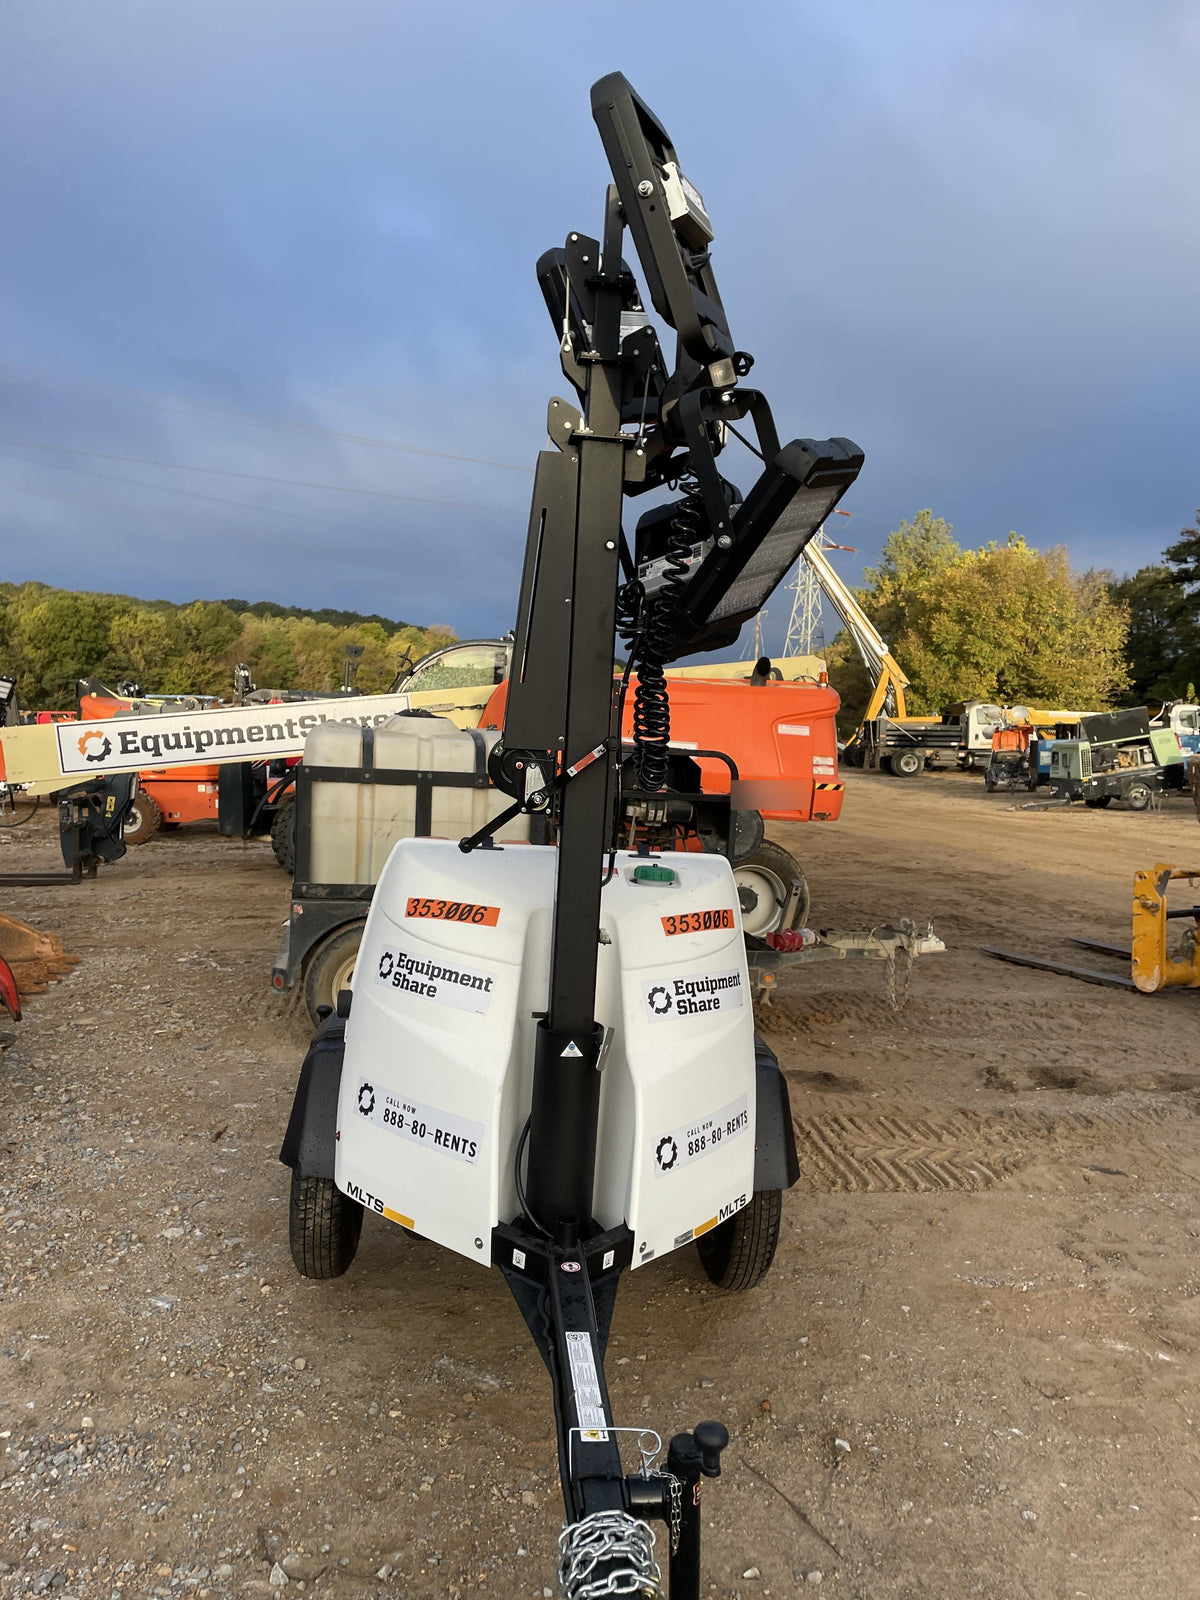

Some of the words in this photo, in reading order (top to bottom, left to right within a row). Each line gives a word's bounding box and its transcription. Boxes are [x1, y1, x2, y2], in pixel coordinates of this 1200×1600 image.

[407, 899, 487, 924] 353006
[666, 910, 729, 935] 353006
[392, 971, 437, 998] Share
[397, 952, 493, 992] Equipment
[673, 972, 741, 997] Equipment
[677, 997, 720, 1015] Share
[385, 1096, 400, 1109] CALL
[402, 1103, 417, 1115] NOW
[383, 1108, 477, 1158] 888-80-RENTS
[687, 1126, 701, 1138] CALL
[702, 1120, 714, 1132] NOW
[688, 1110, 748, 1156] 888-80-RENTS
[346, 1181, 384, 1214] MLTS
[719, 1194, 747, 1221] MLTS
